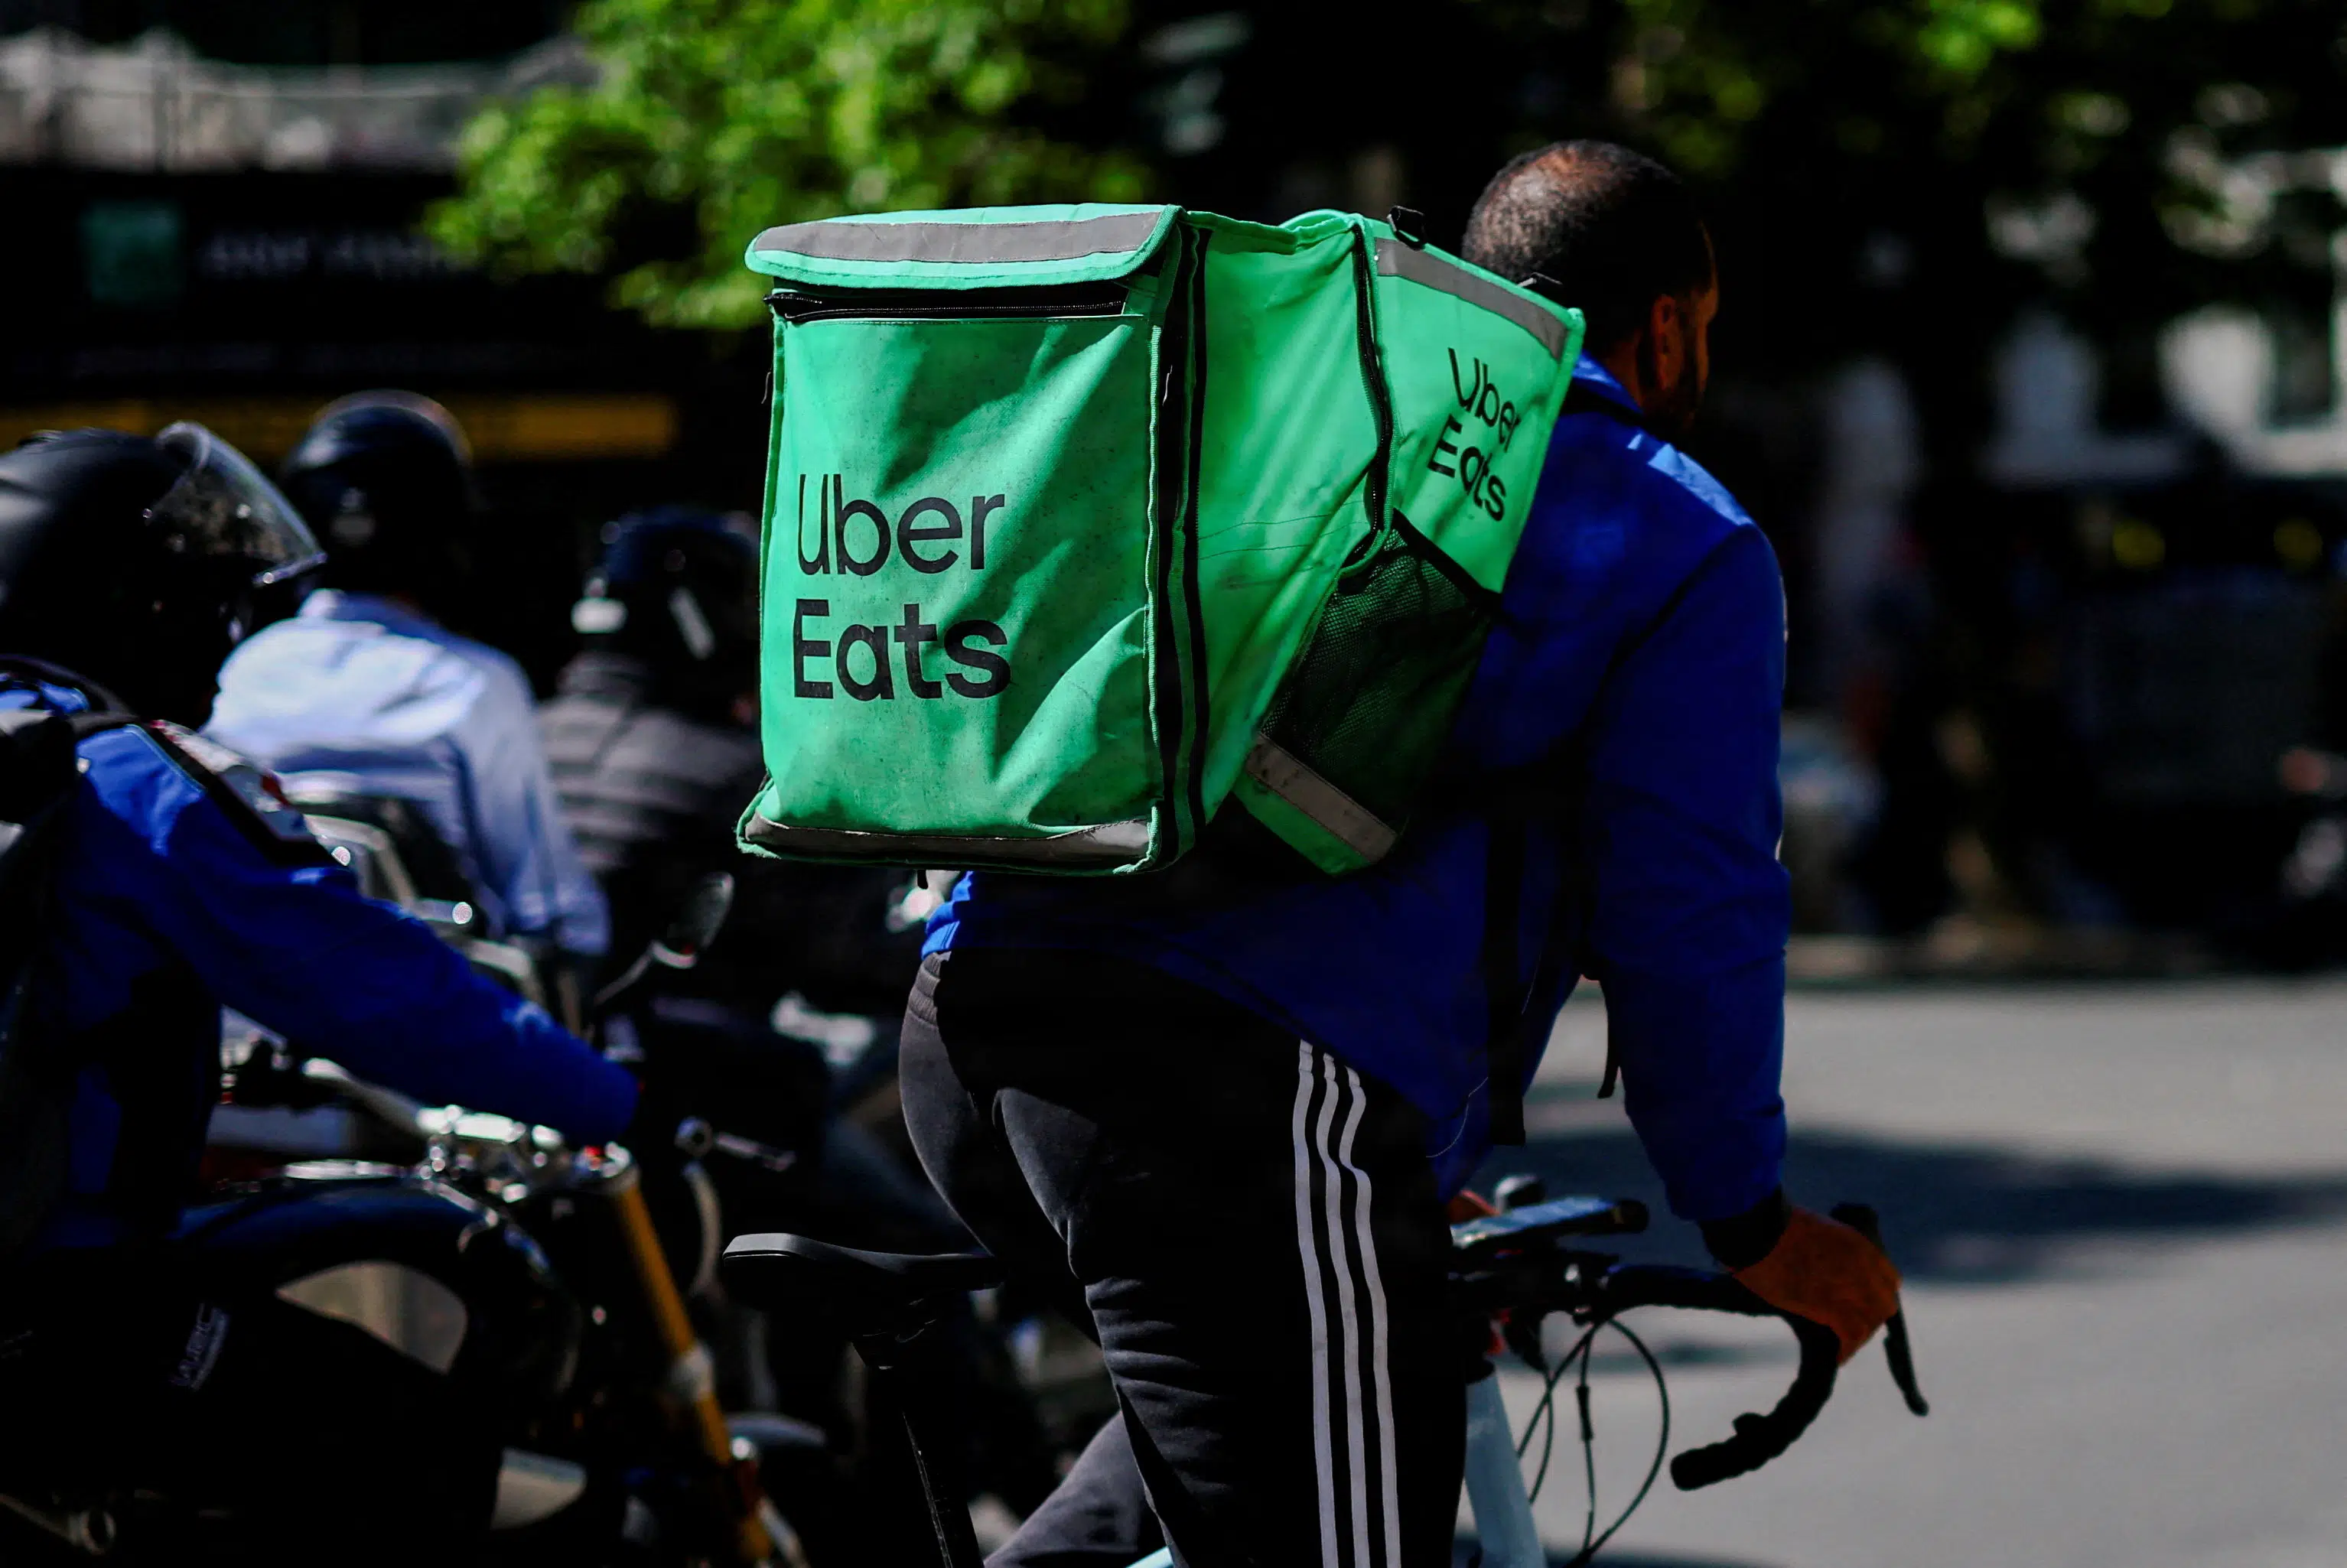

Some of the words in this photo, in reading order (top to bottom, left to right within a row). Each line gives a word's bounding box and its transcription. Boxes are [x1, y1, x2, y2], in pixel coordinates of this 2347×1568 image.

[1447, 346, 1522, 453] Uber
[1427, 413, 1506, 521] Eats
[798, 473, 1005, 575] Uber
[793, 598, 1011, 701] Eats
